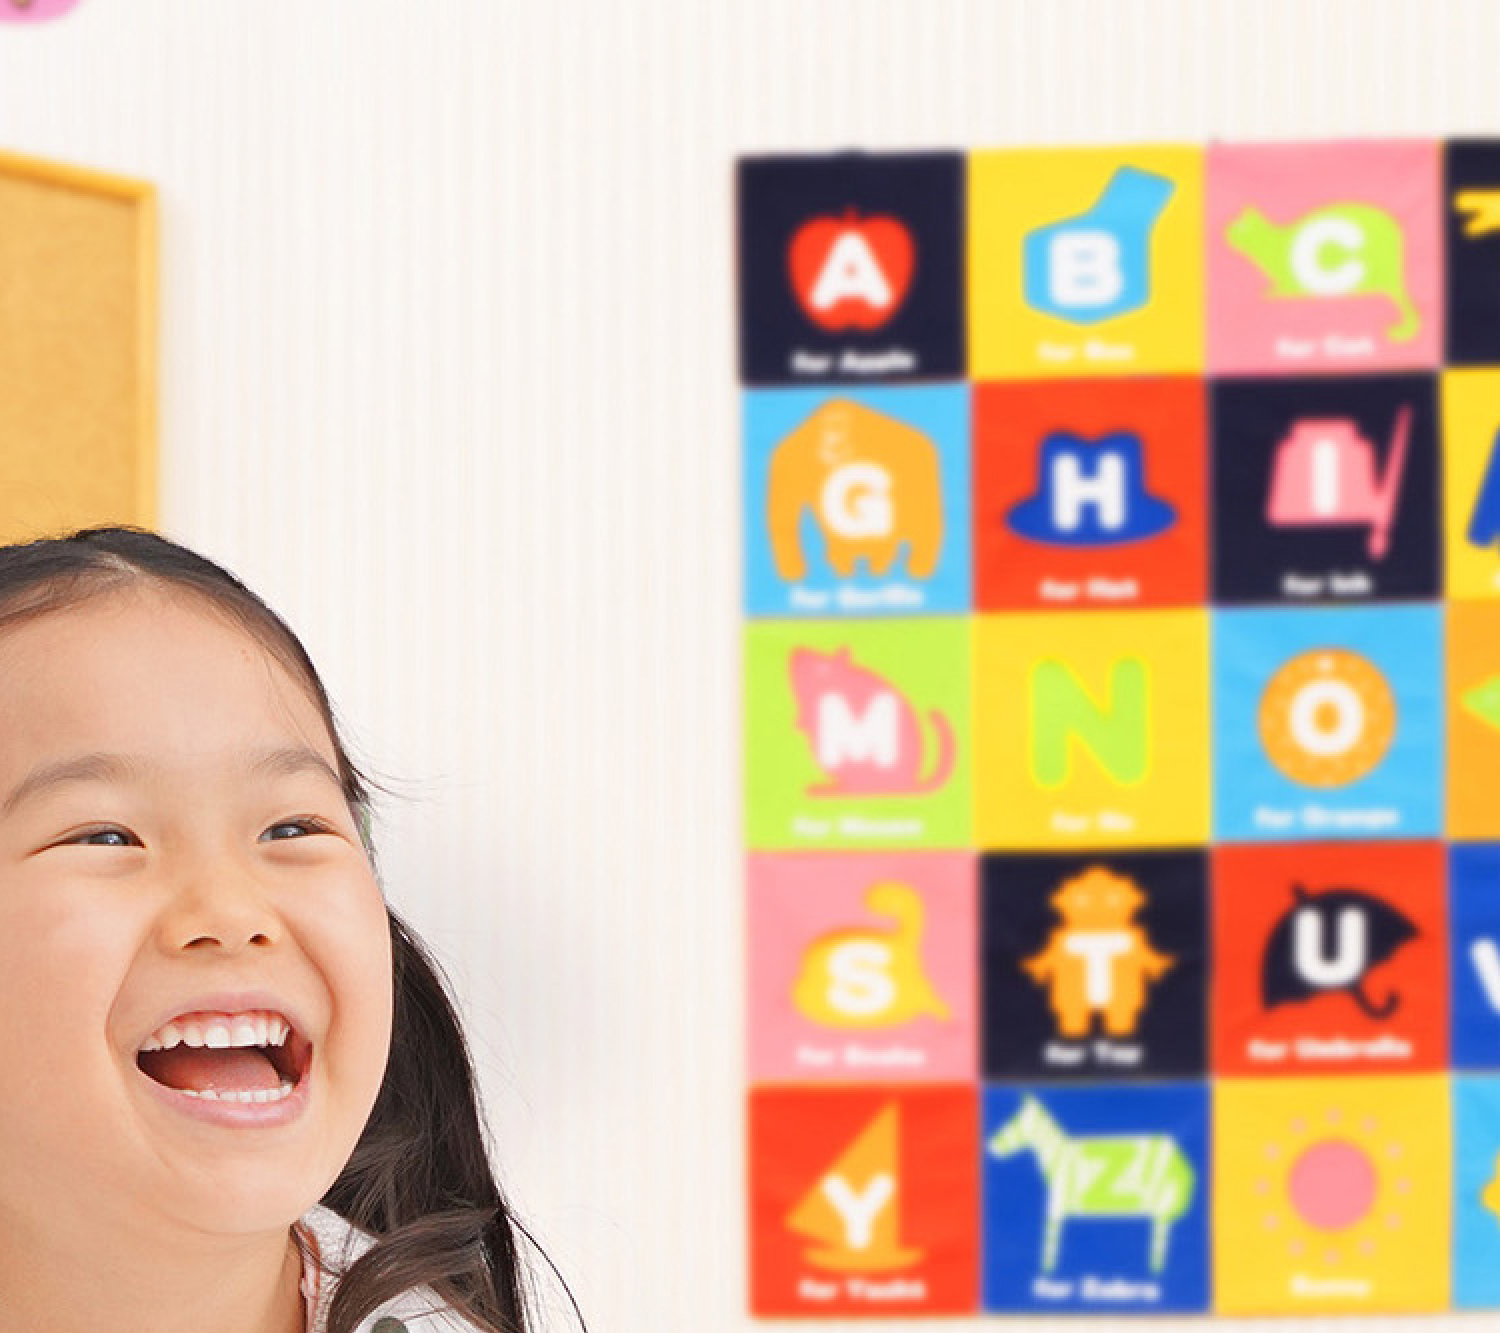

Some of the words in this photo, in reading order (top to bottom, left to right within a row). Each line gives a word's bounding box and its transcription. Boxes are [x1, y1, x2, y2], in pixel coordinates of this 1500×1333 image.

[812, 234, 890, 308] A
[1048, 230, 1124, 308] B
[1292, 218, 1364, 298] C
[822, 462, 892, 538] G
[1054, 454, 1124, 530] H
[1310, 438, 1340, 516] I
[816, 692, 900, 770] M
[1032, 658, 1148, 786] N
[1290, 680, 1364, 756] O
[828, 942, 896, 1016] S
[1066, 932, 1132, 1006] T
[1296, 910, 1364, 986] U
[824, 1176, 894, 1250] Y
